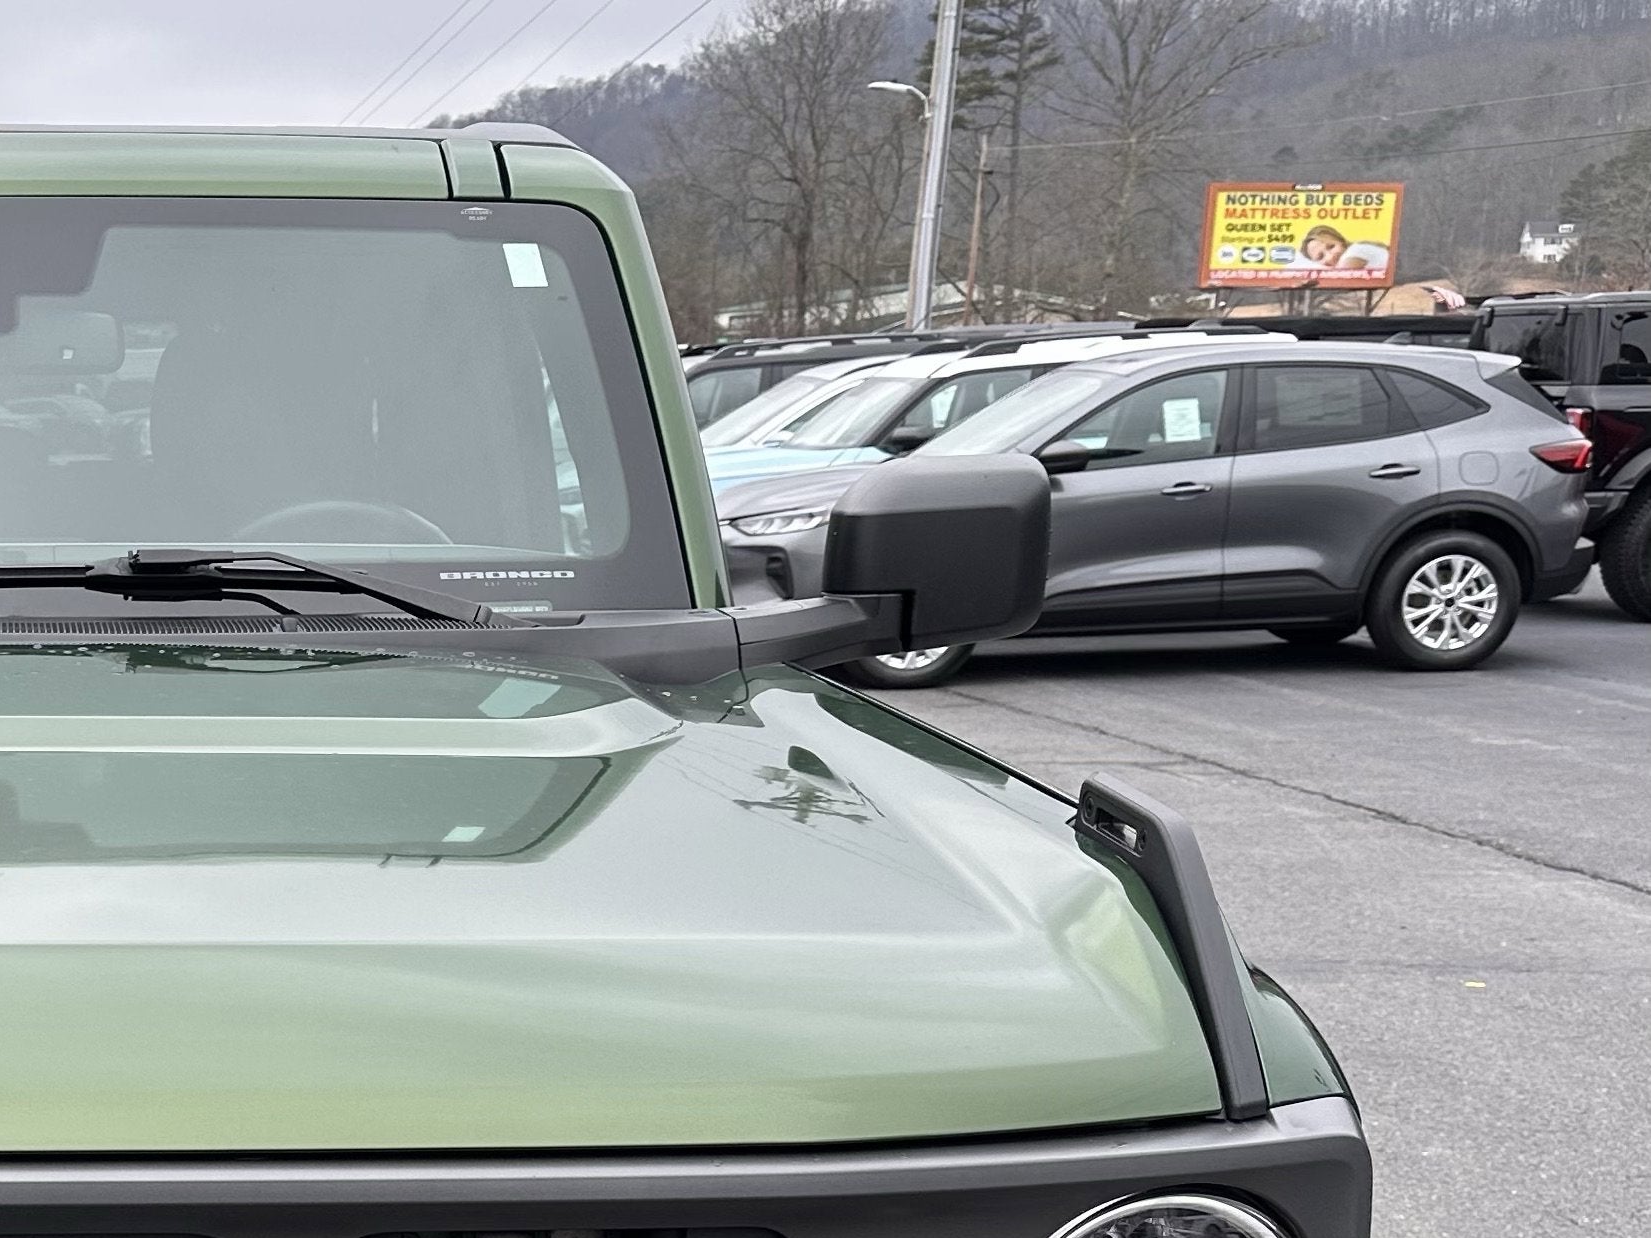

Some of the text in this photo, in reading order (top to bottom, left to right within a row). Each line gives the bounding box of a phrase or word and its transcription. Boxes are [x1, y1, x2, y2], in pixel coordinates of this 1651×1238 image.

[1225, 194, 1384, 206] NOTHING BUT BEDS
[1224, 207, 1383, 220] MATTRESS OUTLET
[1225, 223, 1292, 232] QUEEN SET
[439, 571, 575, 580] BRONCO
